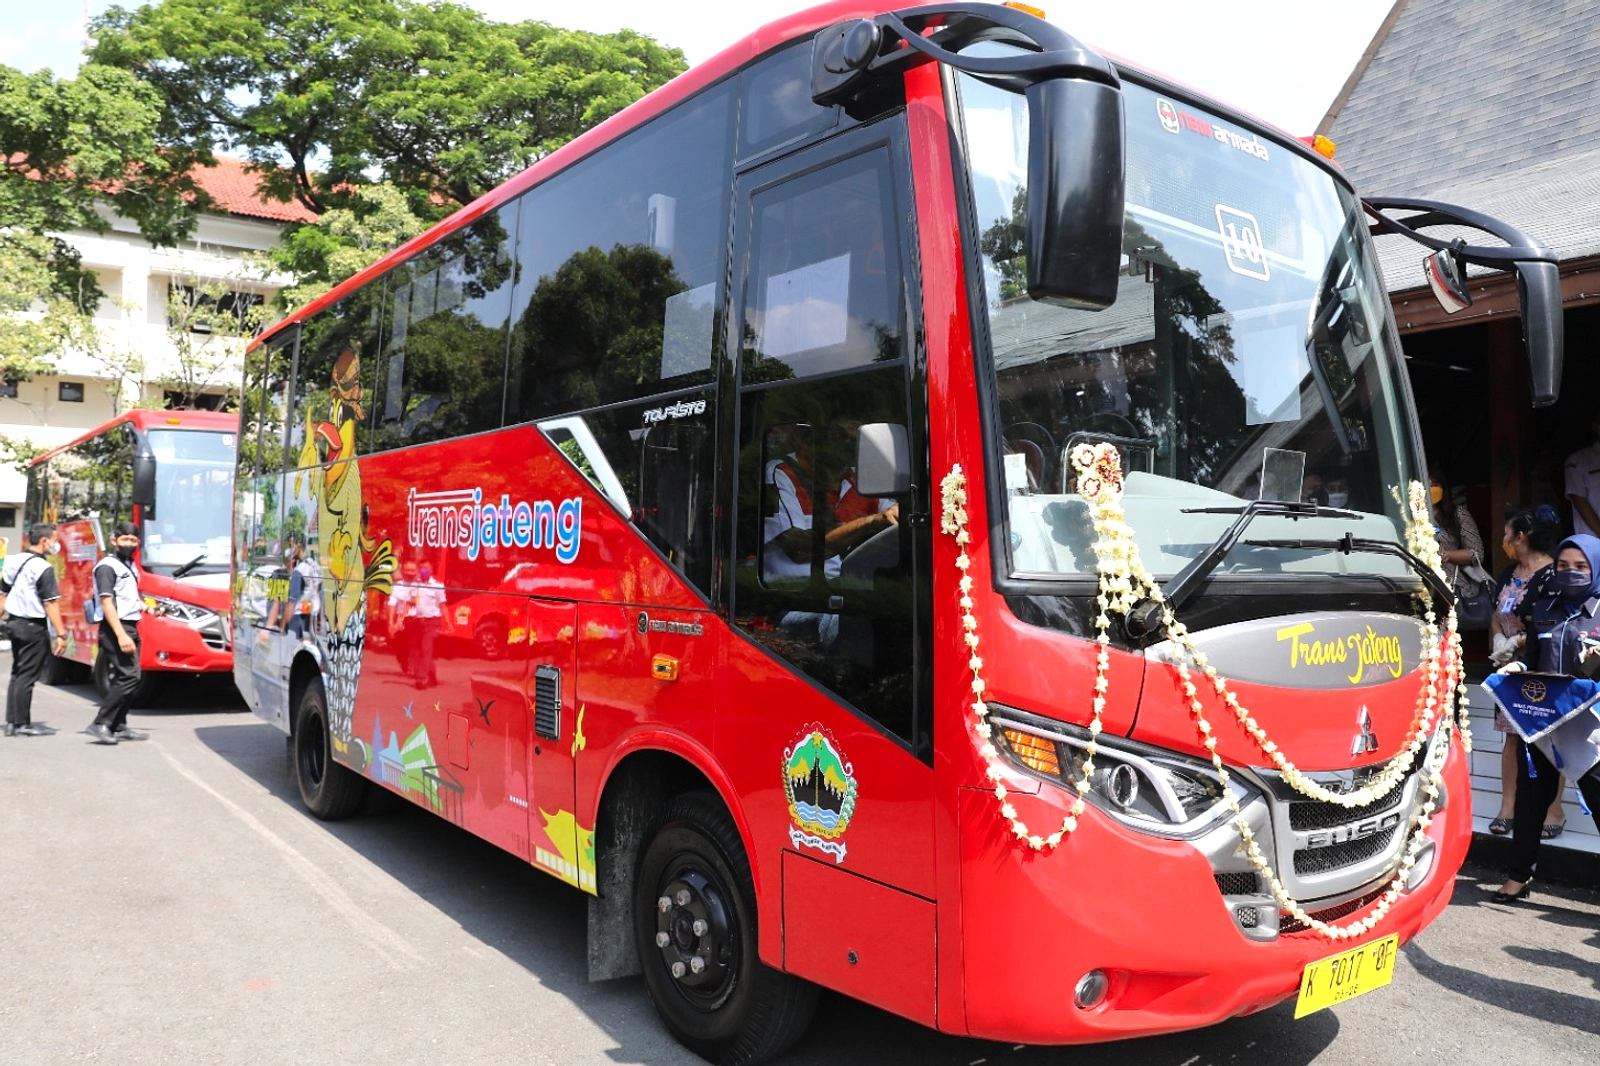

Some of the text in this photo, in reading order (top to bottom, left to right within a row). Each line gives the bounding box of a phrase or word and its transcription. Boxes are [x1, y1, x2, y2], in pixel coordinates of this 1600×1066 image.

[1225, 222, 1259, 263] 10
[407, 486, 583, 565] transjateng
[1275, 622, 1348, 669] Trans
[1305, 966, 1319, 998] K
[1328, 949, 1365, 990] 7017
